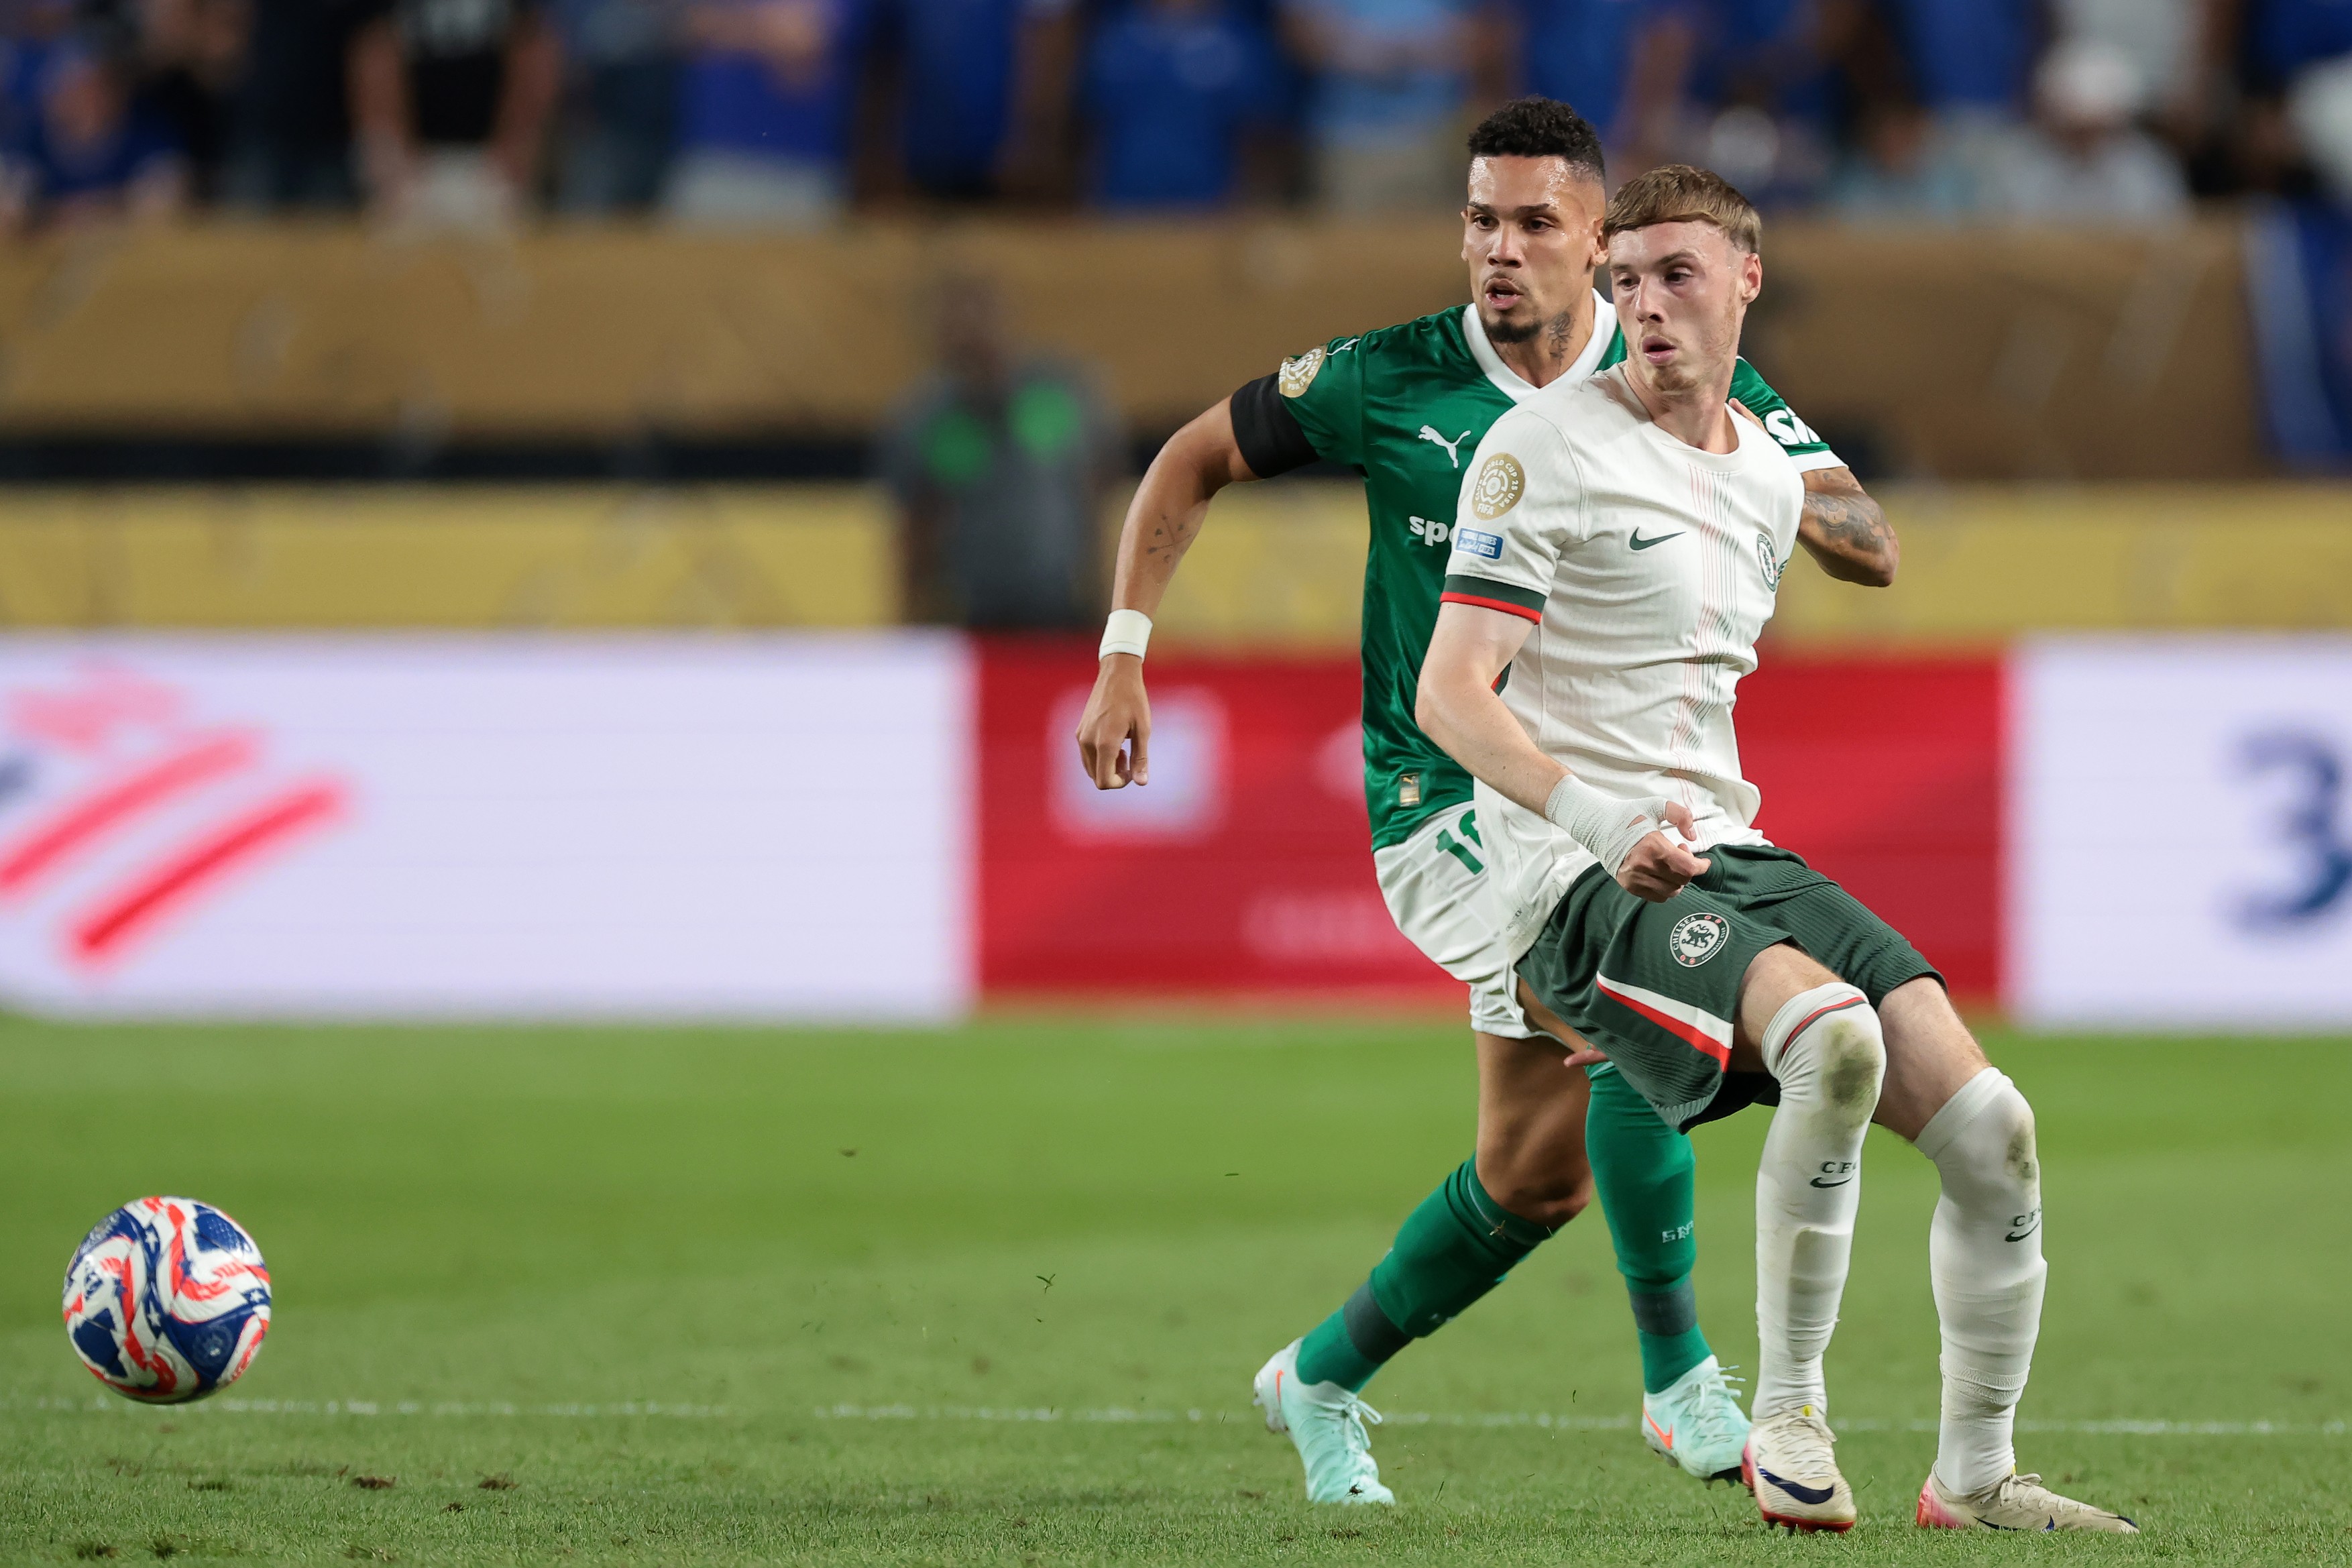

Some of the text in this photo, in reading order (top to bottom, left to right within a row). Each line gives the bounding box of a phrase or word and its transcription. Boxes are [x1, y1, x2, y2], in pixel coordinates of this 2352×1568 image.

[1482, 459, 1505, 477] WORLD
[1505, 463, 1518, 478] CUP
[1477, 502, 1496, 516] FIFA
[1498, 492, 1516, 508] USA
[1409, 516, 1454, 547] sp
[1673, 916, 1697, 950] CHELSEA
[2013, 1207, 2041, 1227] CF
